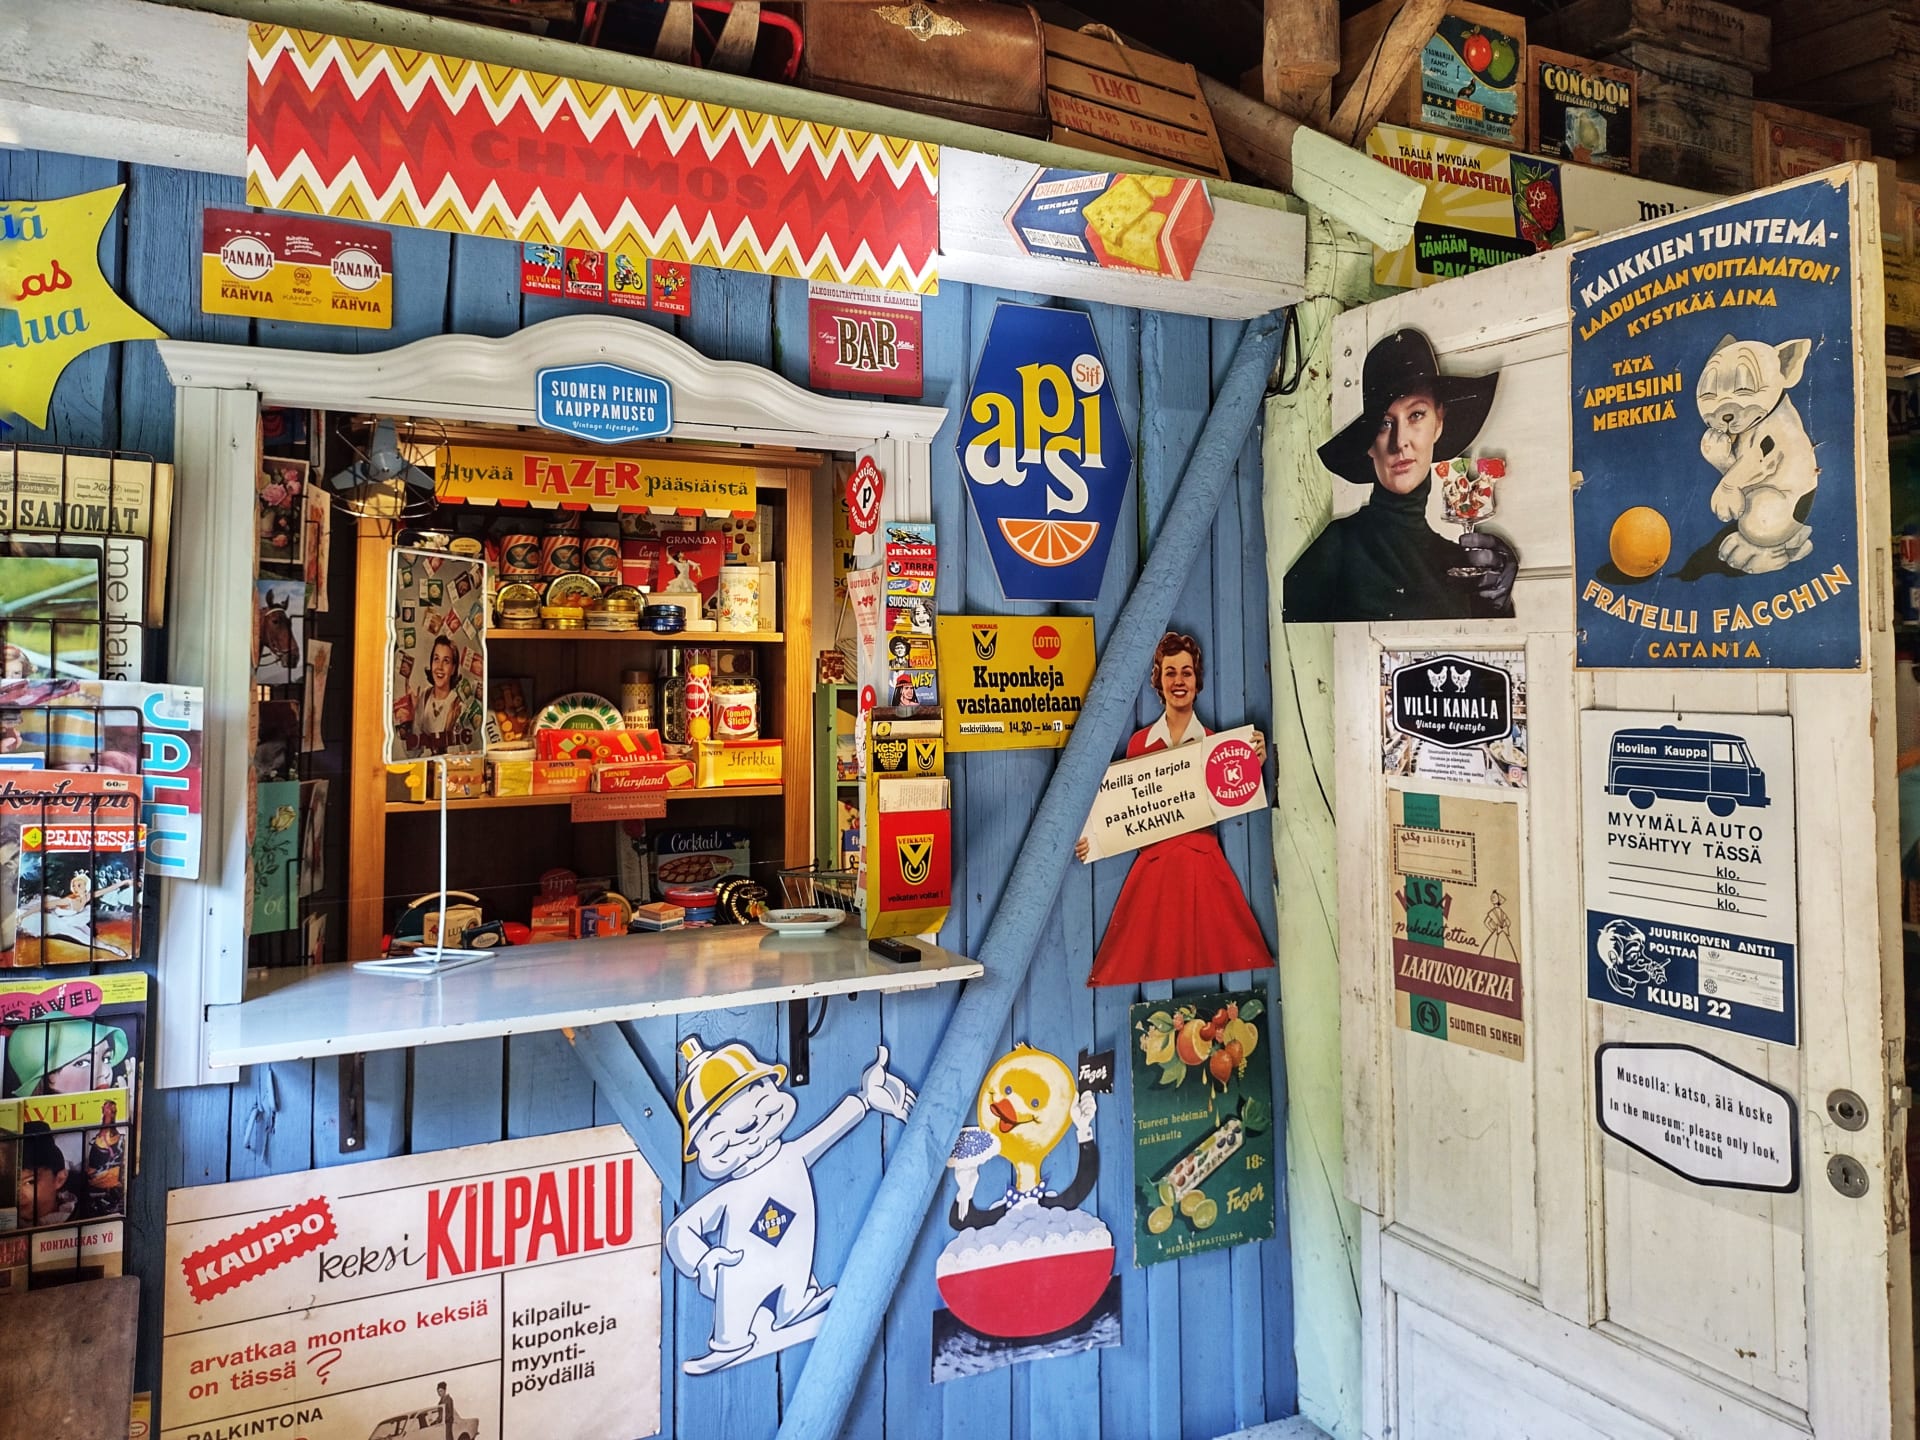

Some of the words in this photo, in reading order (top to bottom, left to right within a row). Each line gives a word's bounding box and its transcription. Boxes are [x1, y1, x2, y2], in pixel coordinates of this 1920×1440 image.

[1544, 68, 1630, 108] CONGDON
[470, 127, 768, 211] CHYMOS
[1399, 145, 1432, 161] TÄÄLLÄ
[1437, 151, 1481, 170] MYYDÄÄN
[1034, 183, 1065, 198] CREAM
[1437, 164, 1512, 195] PAKASTEITA
[1418, 234, 1468, 258] TÄNÄÄN
[222, 248, 274, 269] PANAMA
[332, 261, 382, 280] PANAMA
[1580, 232, 1694, 308] KAIKKIEN
[1699, 218, 1838, 252] TUNTEMA-
[526, 282, 561, 291] JENKKI
[566, 286, 602, 297] JENKKI
[570, 281, 601, 290] Tarzan
[221, 287, 273, 304] KAHVIA
[331, 298, 381, 313] KAHVIA
[611, 297, 646, 307] JENKKI
[654, 301, 685, 312] JENKKI
[1580, 268, 1690, 341] LAADULTAAN
[1692, 255, 1841, 286] VOITTAMATON!
[1627, 290, 1716, 338] KYSYKÄÄ
[1720, 287, 1777, 307] AINA
[832, 315, 899, 372] BAR
[1075, 363, 1102, 387] Siff
[1612, 354, 1655, 378] TÄTÄ
[551, 381, 606, 400] SUOMEN
[613, 386, 658, 404] PIENIN
[1584, 372, 1683, 409] APPELSIINI
[555, 400, 656, 422] KAUPPAMUSEO
[1593, 400, 1678, 432] MERKKIÄ
[572, 421, 602, 432] Vintage
[605, 423, 639, 432] lifestyle
[440, 461, 514, 482] Hyvää
[523, 455, 643, 498] FAZER
[644, 475, 749, 498] pääsiäistä
[19, 499, 140, 534] SANOMAT
[666, 536, 717, 545] GRANADA
[888, 548, 932, 556] JENKKI
[105, 545, 129, 604] me
[889, 582, 908, 590] Ford
[888, 596, 921, 608] SUOSIKKI
[1582, 579, 1698, 634] FRATELLI
[1713, 563, 1852, 633] FACCHIN
[1033, 635, 1061, 648] LOTTO
[1648, 640, 1761, 659] CATANIA
[910, 671, 935, 688] WEST
[973, 665, 1065, 692] Kuponkeja
[725, 708, 750, 718] Tomato
[957, 693, 1082, 715] vastaanotetaan
[1404, 695, 1438, 717] VILLI
[1443, 697, 1499, 720] KANALA
[728, 717, 750, 726] Sticks
[1415, 719, 1446, 732] Vintage
[1448, 720, 1486, 733] lifestyle
[728, 750, 775, 767] Herkku
[873, 739, 907, 754] kesto
[1210, 746, 1252, 765] virkisty
[1616, 742, 1657, 755] Hovilan
[1664, 745, 1708, 759] Kauppa
[142, 692, 191, 868] JALLU
[610, 775, 664, 790] Maryland
[1098, 774, 1134, 793] Meillä
[1137, 770, 1151, 783] on
[1155, 759, 1191, 778] tarjota
[1227, 768, 1240, 782] K
[1131, 783, 1163, 800] Teille
[1215, 781, 1257, 800] kahvilla
[1105, 790, 1197, 828] paahtotuoretta
[1124, 808, 1185, 837] K-KAHVIA
[1608, 811, 1763, 842] MYYMÄLÄAUTO
[45, 829, 136, 846] PRINSESSA
[671, 831, 722, 853] Cocktail
[898, 836, 933, 845] VEIKKAUS
[1401, 831, 1421, 844] KISA
[1422, 836, 1467, 849] säilöttyä
[1607, 833, 1692, 855] PYSÄHTYY
[1703, 841, 1762, 864] TÄSSÄ
[1716, 866, 1740, 880] klo.
[1394, 881, 1453, 920] KISA
[1717, 882, 1740, 896] klo.
[1717, 898, 1740, 913] klo.
[1394, 918, 1480, 949] puhdistettua
[1649, 926, 1731, 949] JUURIKORVEN
[1737, 941, 1775, 957] ANTTI
[1649, 942, 1698, 960] POLTTAA
[1398, 954, 1515, 1002] LAATUSOKERIA
[1647, 986, 1699, 1012] KLUBI
[1706, 999, 1732, 1019] 22
[1449, 1016, 1487, 1038] SUOMEN
[1490, 1025, 1522, 1047] SOKERI
[1079, 1063, 1108, 1084] Fazer
[1617, 1066, 1670, 1094] Museolla:
[1675, 1083, 1711, 1108] katso,
[1715, 1094, 1733, 1112] älä
[1738, 1101, 1773, 1124] koske
[1138, 1117, 1169, 1130] Tuoreen
[1171, 1108, 1209, 1124] hedelmän
[1610, 1097, 1619, 1111] In
[1623, 1103, 1638, 1117] the
[1642, 1109, 1685, 1132] museum:
[1689, 1124, 1723, 1143] please
[1726, 1135, 1748, 1154] only
[1752, 1142, 1780, 1164] look,
[1664, 1129, 1690, 1149] don't
[1694, 1139, 1723, 1159] touch
[1226, 1182, 1265, 1215] Fazer
[318, 1232, 428, 1283] keksi
[426, 1158, 635, 1281] KILPAILU
[757, 1213, 788, 1232] Kosan
[101, 1230, 114, 1244] YÖ
[195, 1211, 325, 1286] KAUPPO
[510, 1299, 592, 1328] kilpailu-
[189, 1339, 297, 1375] arvatkaa
[307, 1317, 407, 1350] montako
[416, 1299, 489, 1330] keksiä
[510, 1315, 617, 1351] kuponkeja
[510, 1345, 586, 1373] myynti-
[188, 1382, 219, 1400] on
[231, 1360, 297, 1390] tässä
[510, 1361, 596, 1398] pöydällä
